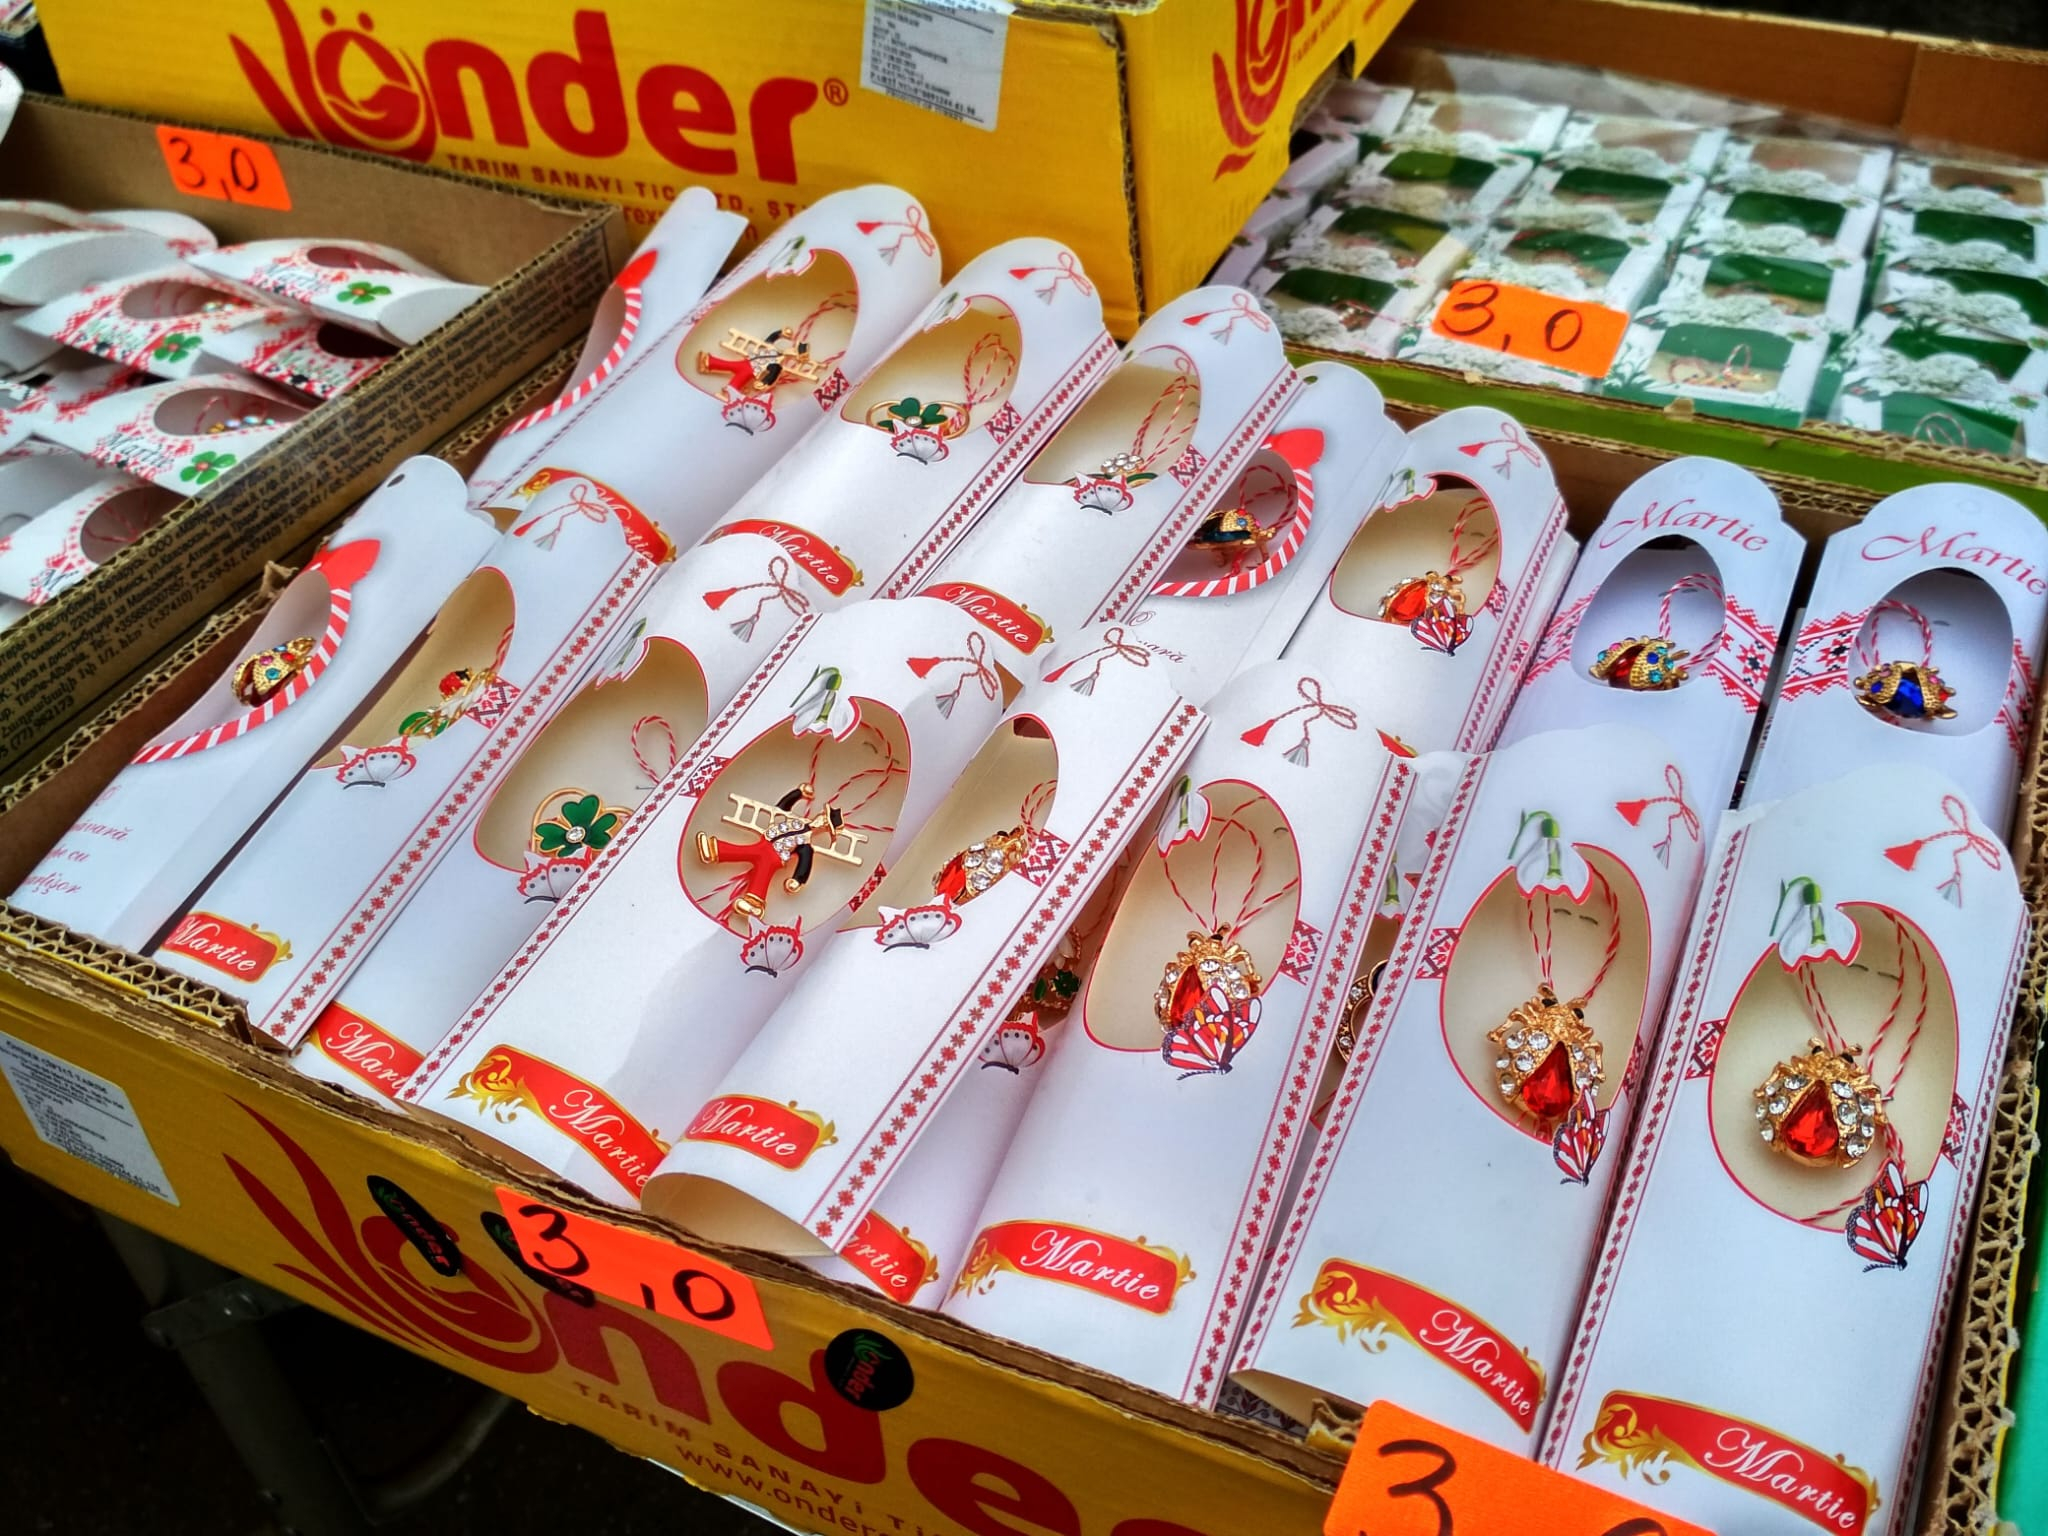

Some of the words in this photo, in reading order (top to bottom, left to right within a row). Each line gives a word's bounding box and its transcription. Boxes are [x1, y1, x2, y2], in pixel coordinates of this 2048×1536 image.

[169, 136, 259, 202] 3,0
[448, 153, 520, 179] TARIM
[1440, 283, 1582, 352] 3,0
[759, 525, 840, 586] Martie
[1600, 499, 1769, 551] Martie
[1861, 527, 2047, 595] Martie
[945, 585, 1029, 645] Martie
[169, 915, 257, 972] Martie
[325, 1021, 408, 1092] Mart
[549, 1088, 649, 1188] Martie
[689, 1100, 796, 1156] Martie
[519, 1204, 737, 1321] 3,0
[847, 1217, 908, 1287] rtie
[1019, 1229, 1161, 1300] Martie
[1419, 1309, 1532, 1417] Martie
[574, 1381, 692, 1441] TARIM
[676, 1445, 892, 1536] www.onder
[1704, 1426, 1856, 1531] Martie
